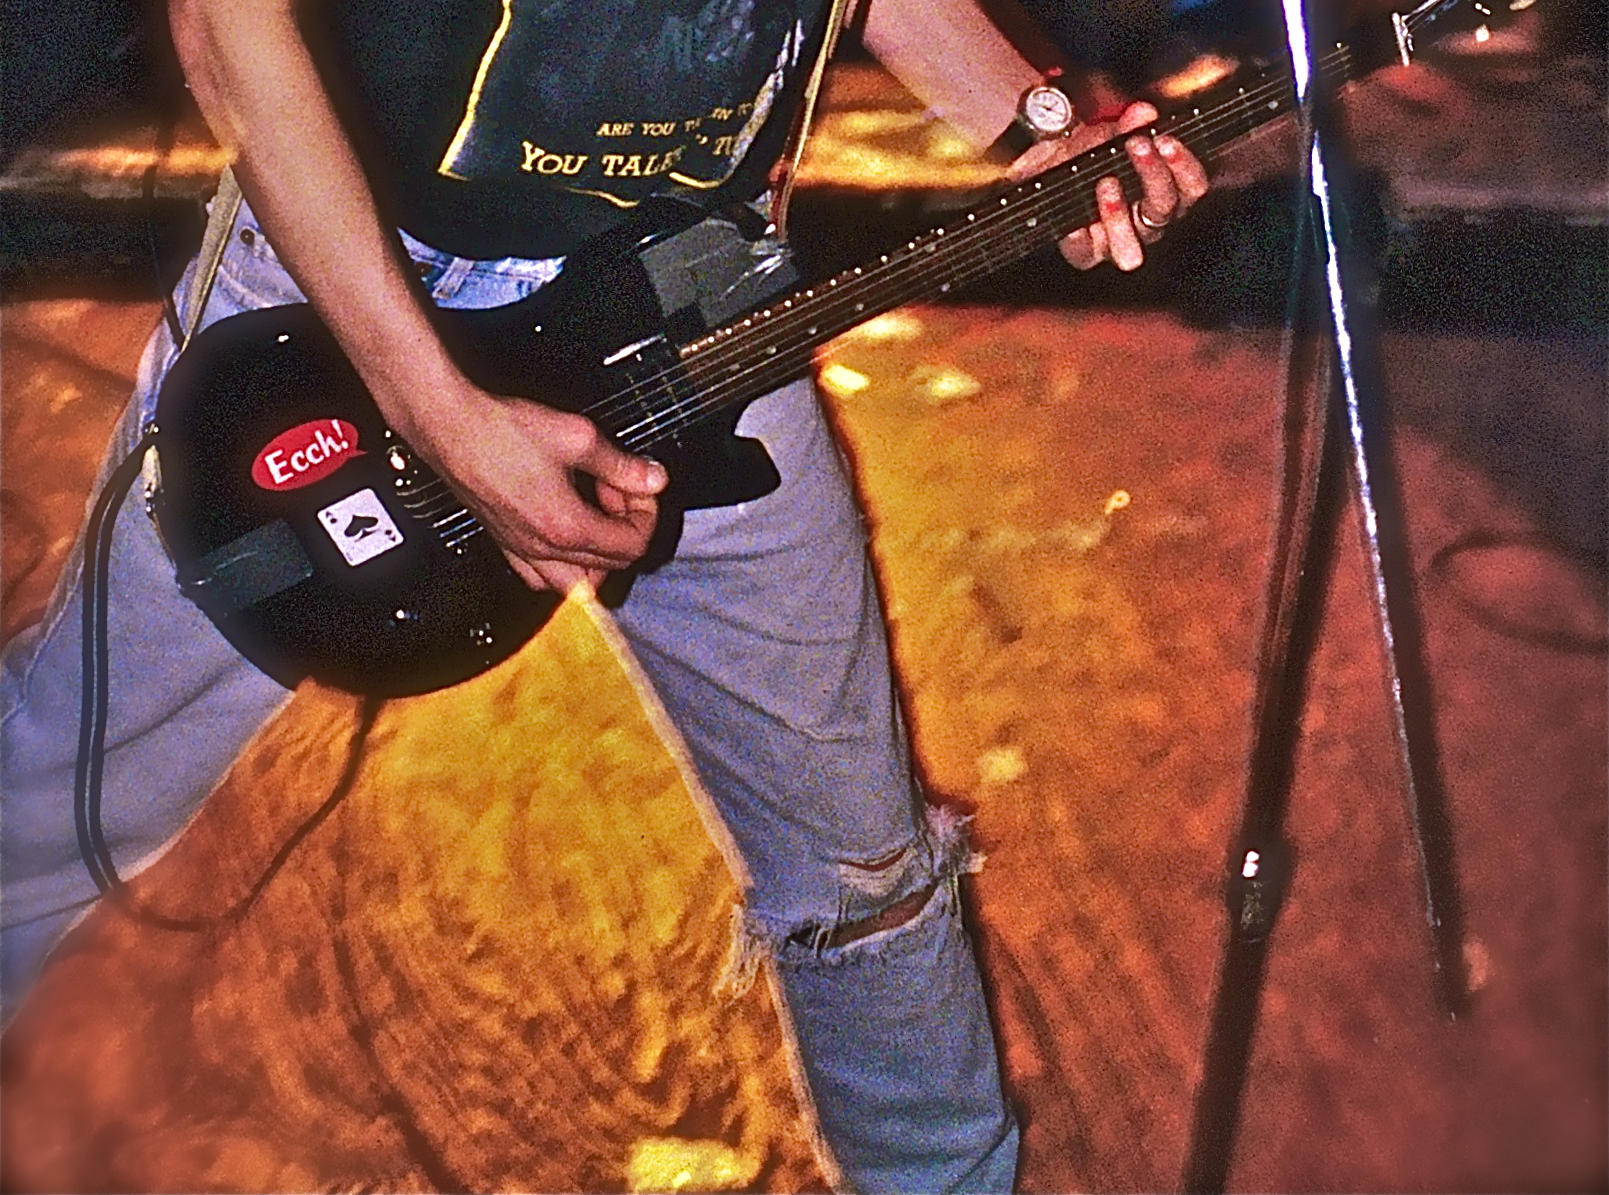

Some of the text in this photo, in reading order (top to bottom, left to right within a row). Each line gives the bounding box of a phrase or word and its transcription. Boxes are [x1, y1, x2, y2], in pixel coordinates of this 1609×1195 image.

[596, 122, 635, 137] ARE
[641, 121, 677, 137] YOU
[520, 140, 588, 175] YOU
[264, 418, 349, 485] Ecch!
